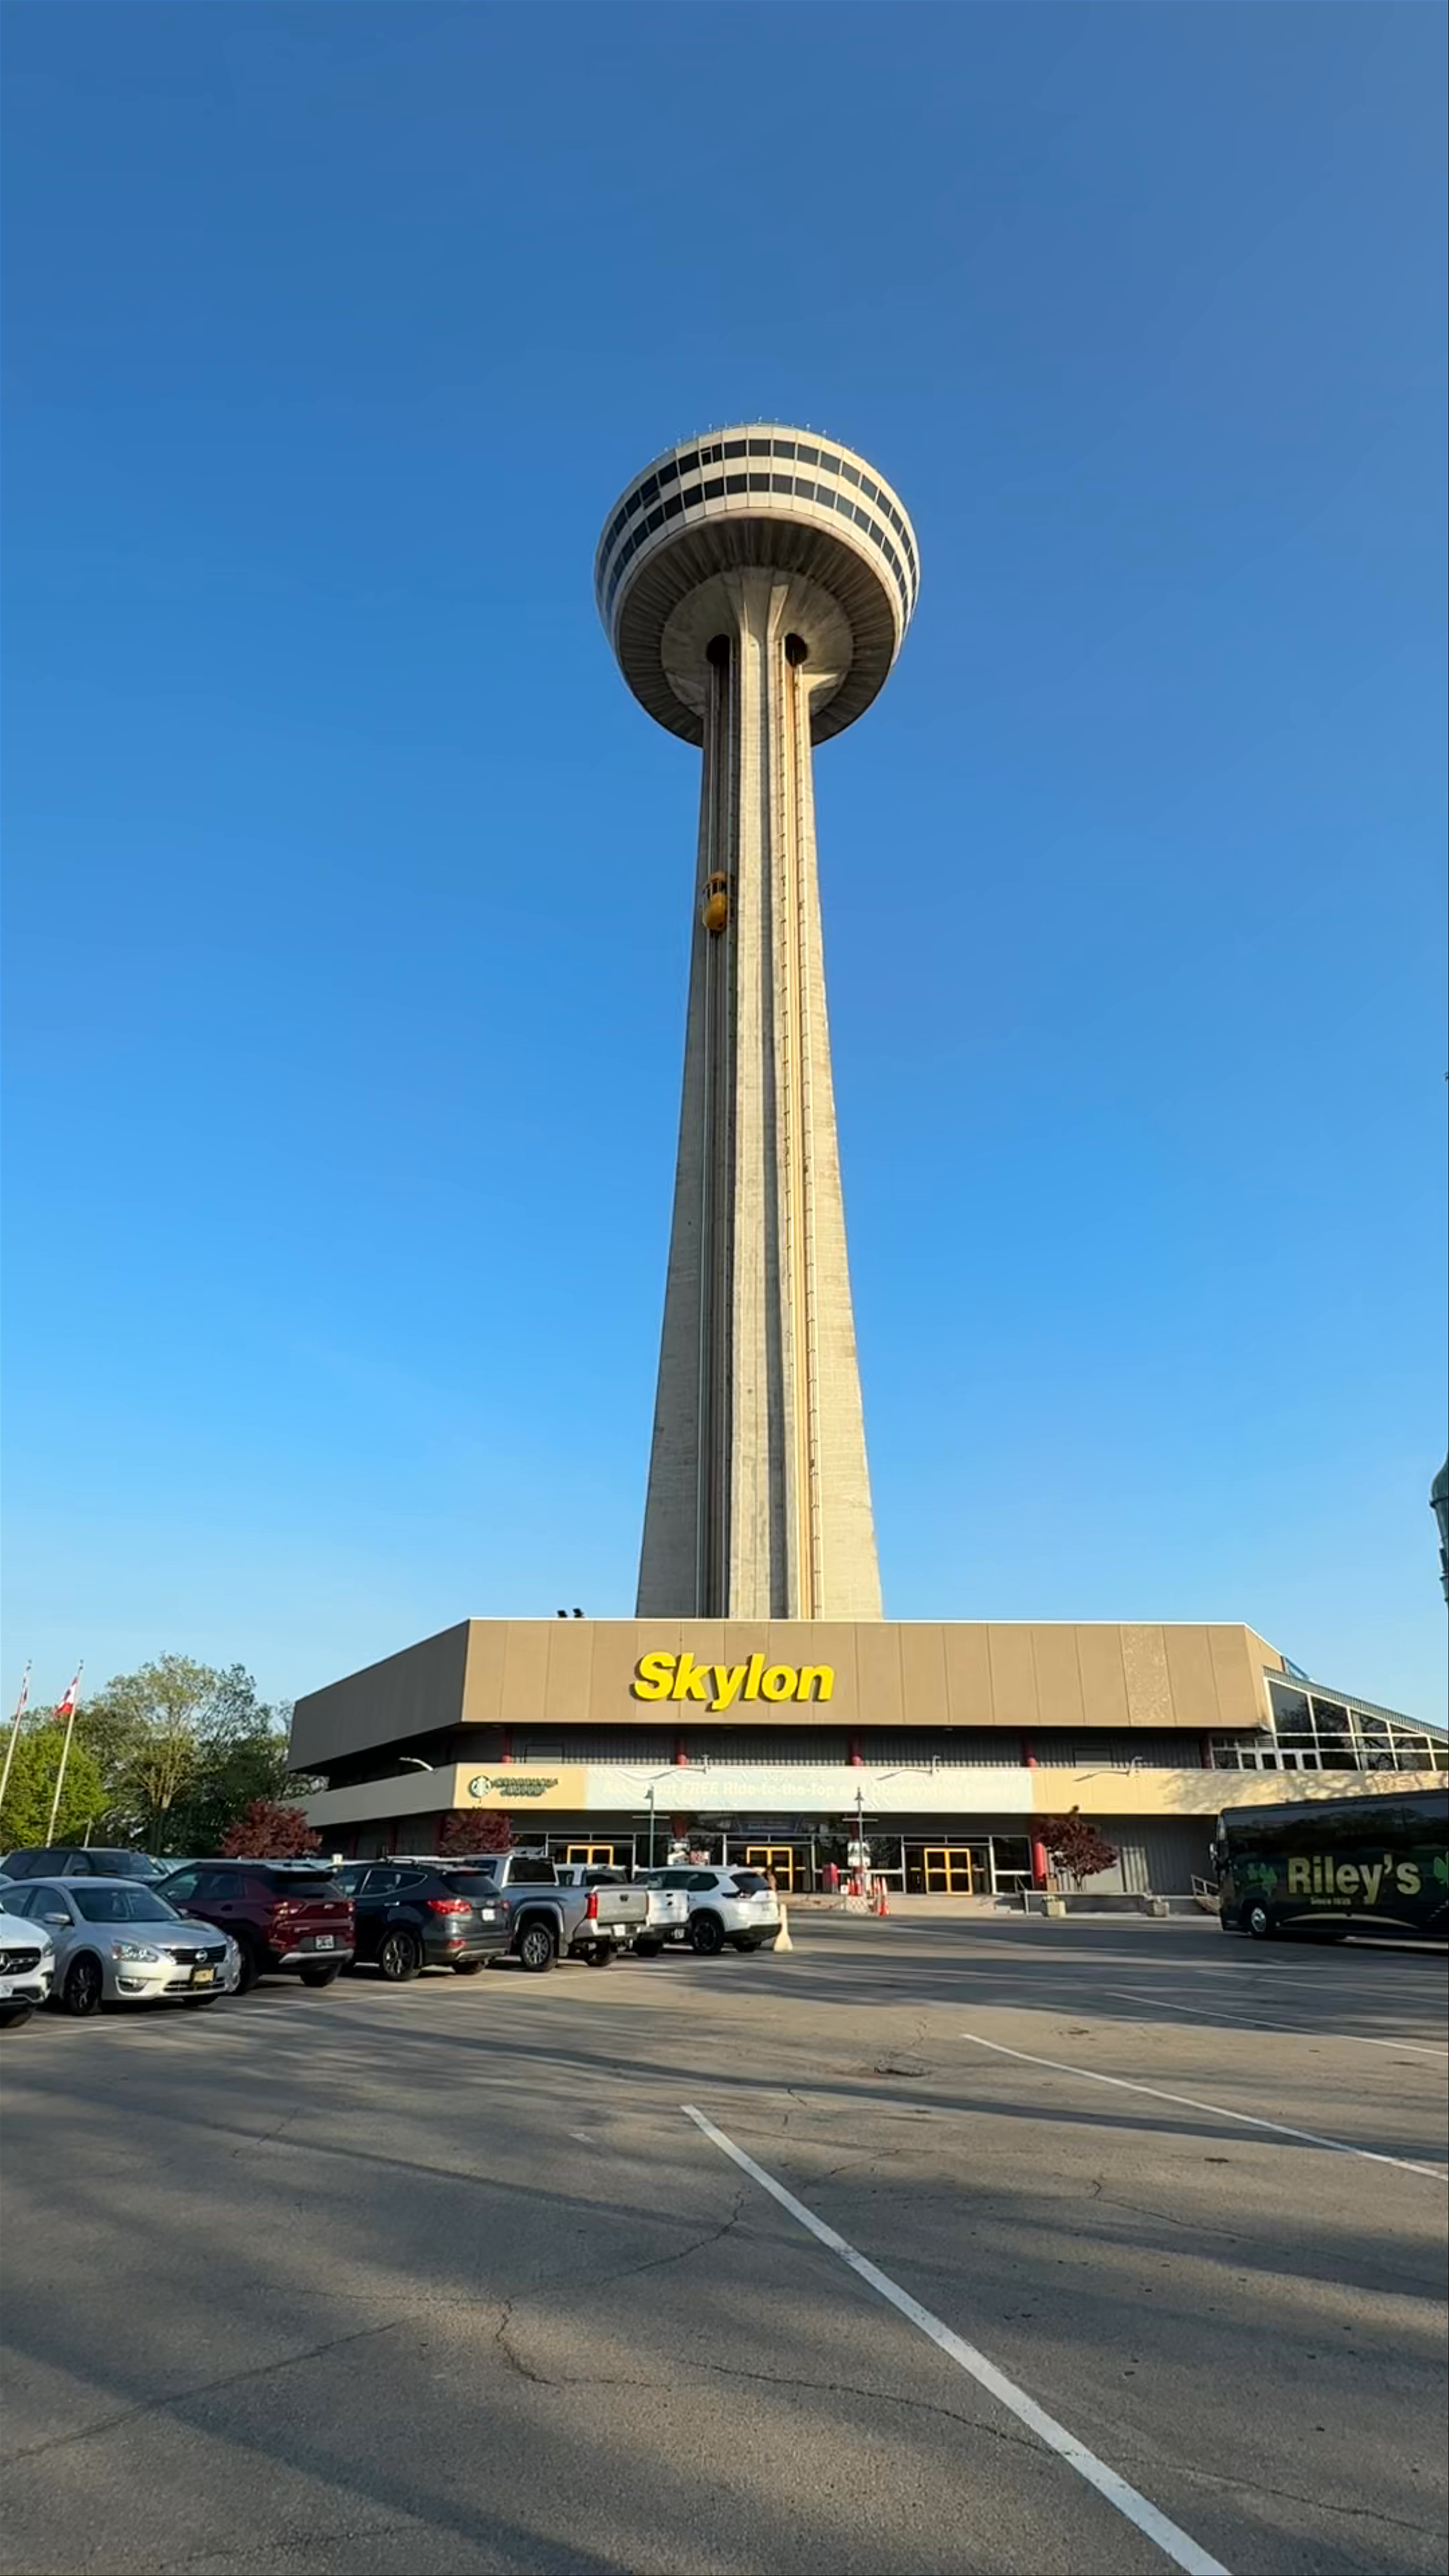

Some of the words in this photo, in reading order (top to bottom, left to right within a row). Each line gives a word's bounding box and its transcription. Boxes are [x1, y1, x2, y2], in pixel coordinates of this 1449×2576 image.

[633, 1651, 835, 1710] Skylon
[681, 1781, 720, 1795] FREE
[1287, 1854, 1421, 1905] Riley's
